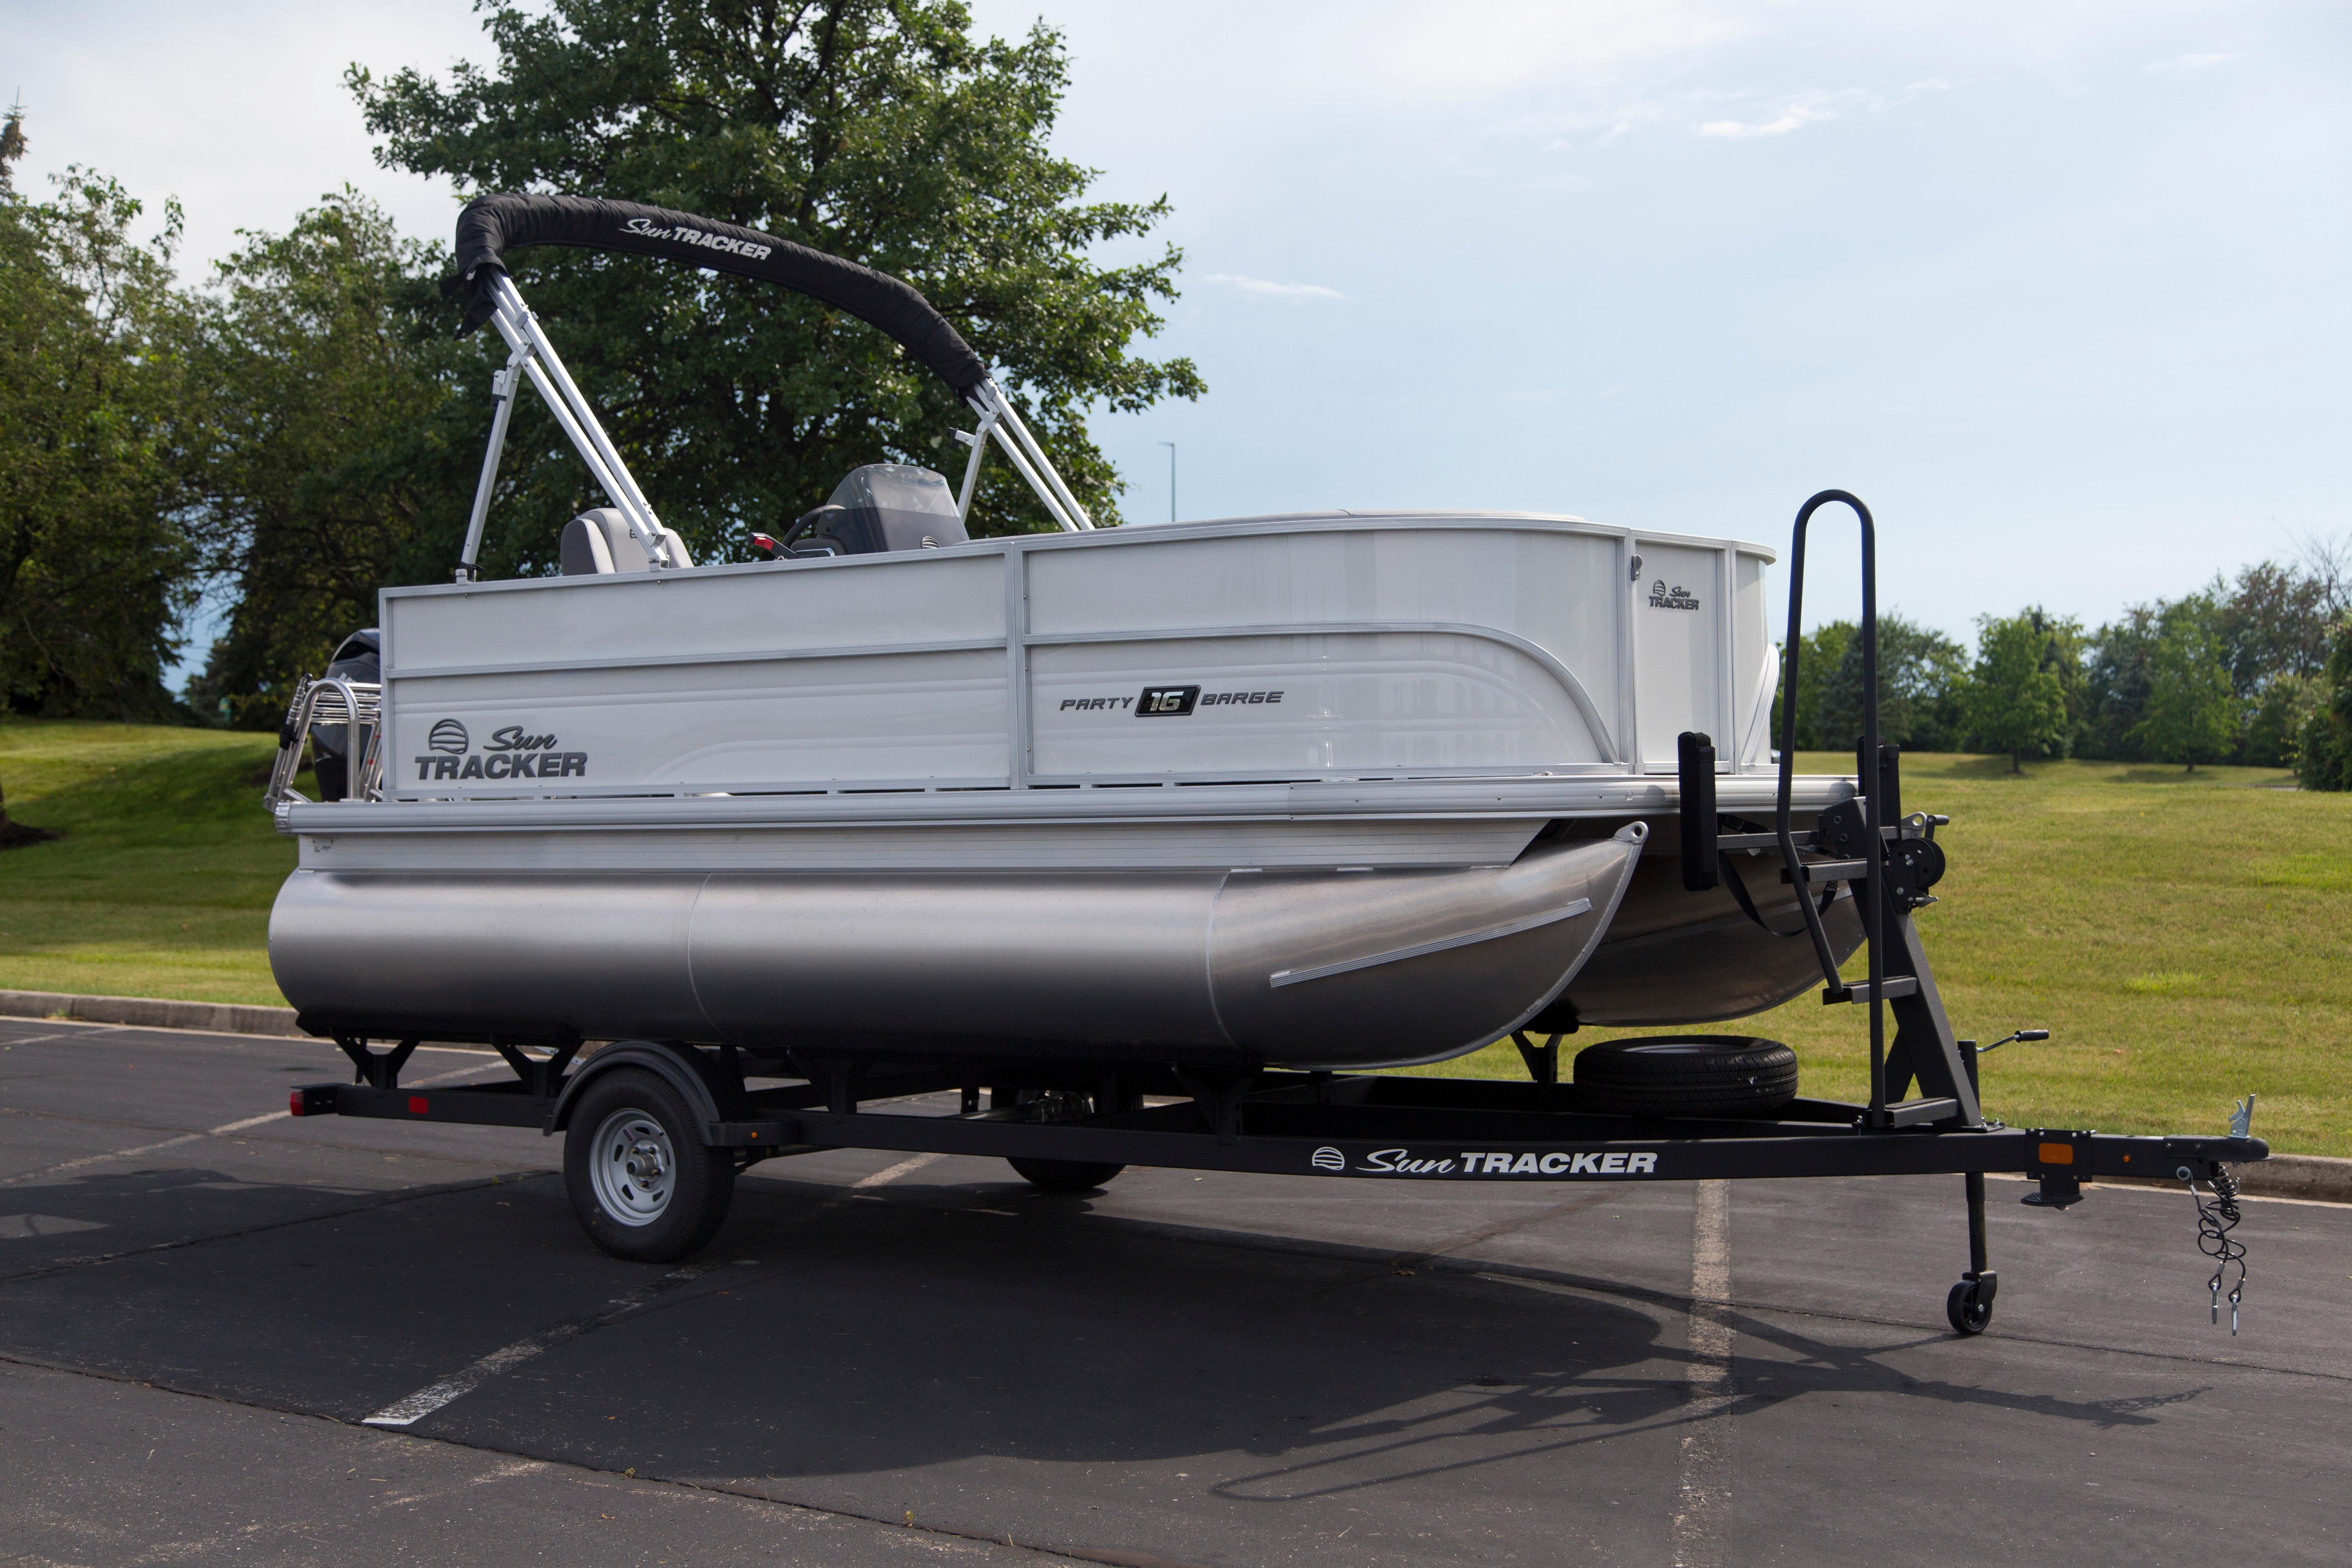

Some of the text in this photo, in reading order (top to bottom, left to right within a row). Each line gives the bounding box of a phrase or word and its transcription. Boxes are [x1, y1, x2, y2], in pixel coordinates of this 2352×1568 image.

[618, 218, 771, 260] Sun TRACKER
[1649, 596, 1699, 610] TRACKER
[1669, 586, 1691, 598] Sun
[1060, 691, 1283, 711] PARTY 16 BARGE
[483, 725, 558, 751] Sun
[414, 752, 587, 780] TRACKER
[1355, 1149, 1658, 1174] Sun TRACKER
